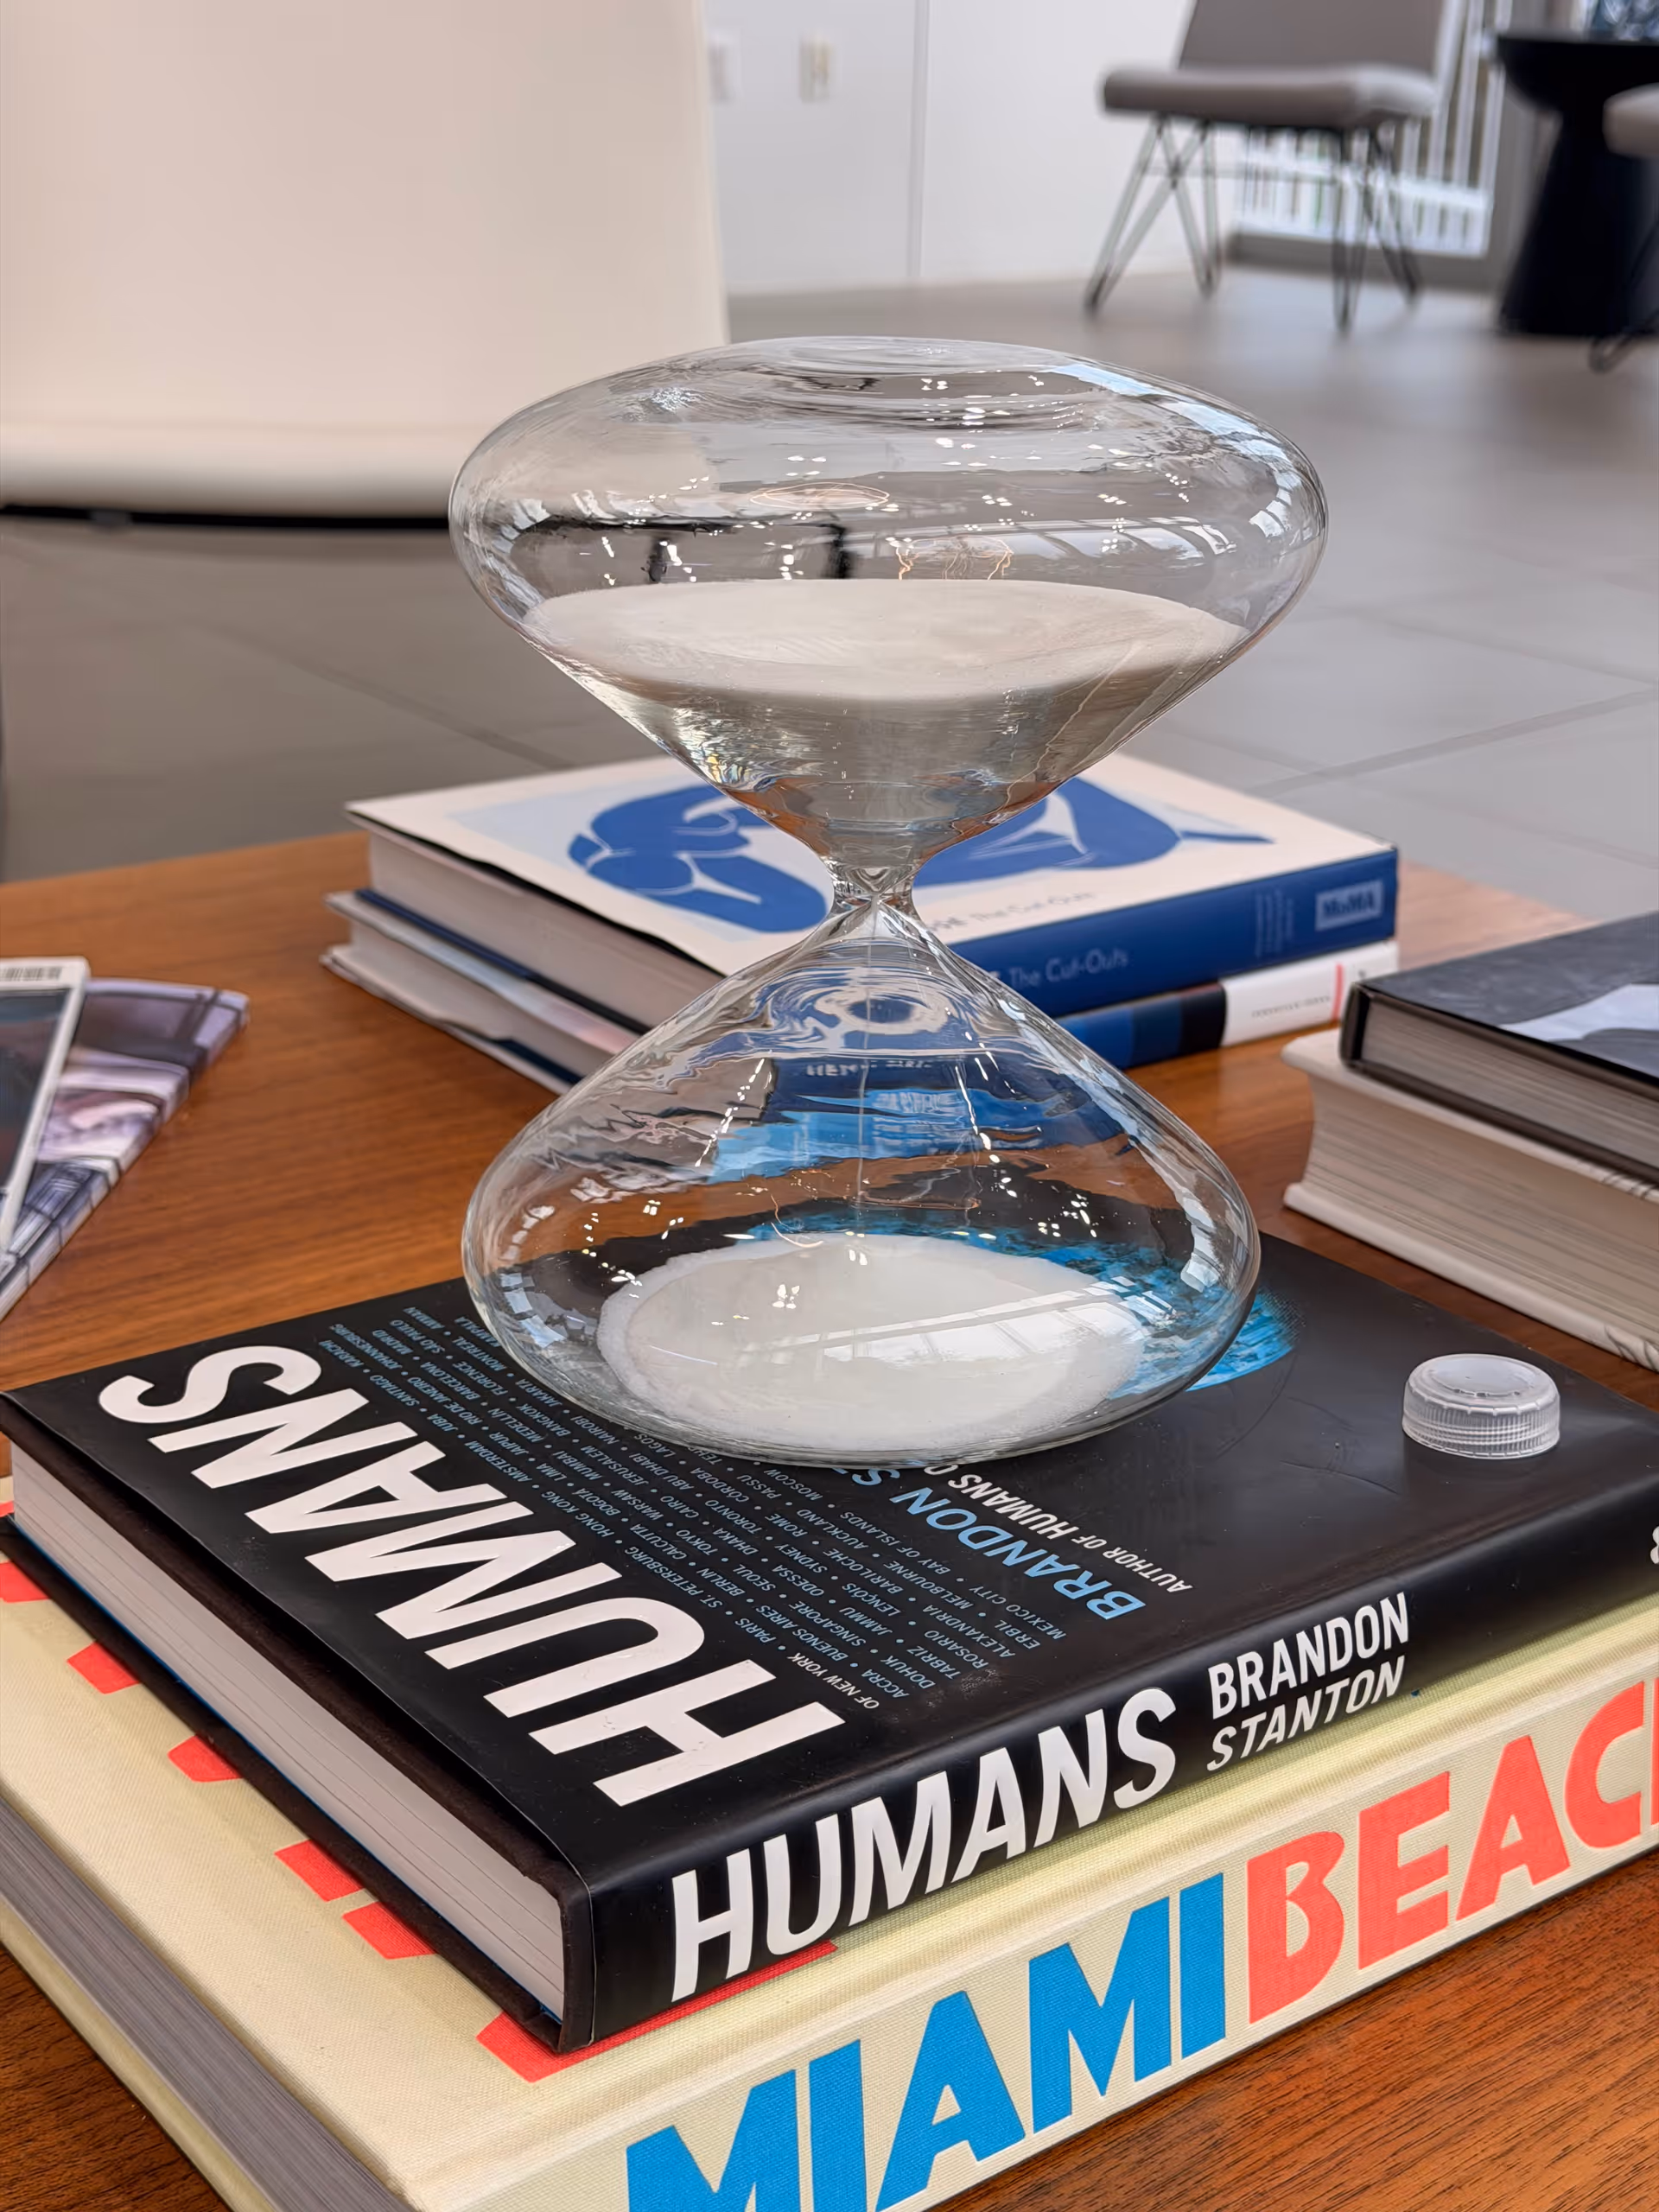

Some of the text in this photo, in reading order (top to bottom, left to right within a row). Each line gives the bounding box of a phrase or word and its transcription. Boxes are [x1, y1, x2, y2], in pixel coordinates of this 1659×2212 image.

[391, 1320, 425, 1340] PAULO
[404, 1307, 444, 1329] AMMAN
[453, 1337, 506, 1370] MONTREAL
[453, 1362, 508, 1395] FLORENCE
[516, 1379, 562, 1407] JAKARTA
[516, 1404, 570, 1436] BANGKOK
[570, 1416, 619, 1444] NAIROBI
[634, 1433, 676, 1457] LAGOS
[581, 1446, 648, 1484] JERUSALEM
[629, 1453, 669, 1475] DHABI
[664, 1476, 694, 1490] ABU
[690, 1468, 749, 1502] CÓRDOBA
[736, 1475, 781, 1498] PASSU
[330, 1324, 909, 1697] ACCRA BUENOS AIRES BERLIN CALCUTTA BOGOTÁ LIMA JAIPUR RIO DE JANEIRO JOHANNESBURG
[372, 1330, 935, 1688] DOHUK SINGAPORE SEOUL TOKYO WARSAW MUMBAI MEDELLÍN BARCELONA MADRID
[660, 1496, 699, 1517] CAIRO
[705, 1500, 761, 1534] TORONTO
[948, 1475, 1078, 1539] HUMANS
[319, 1340, 879, 1708] OF NEW YORK PARIS ST. PETERSBURG HONG KONG AMSTERDAM JUBA SANTIAGO KARACHI
[765, 1514, 807, 1536] ROME
[797, 1510, 868, 1548] AUCKLAND
[713, 1529, 758, 1554] DHAKA
[764, 1470, 1066, 1639] MEXICO CITY BAY OF ISLANDS MOSCOW
[890, 1488, 1146, 1619] BRANDON
[1071, 1535, 1107, 1548] OF
[775, 1544, 827, 1573] SYDNEY
[823, 1548, 903, 1593] BARILOCHE
[1103, 1548, 1192, 1592] AUTHOR
[99, 1345, 845, 1806] HUMANS
[772, 1565, 824, 1596] ODESSA
[884, 1561, 973, 1609] MELBOURNE
[839, 1607, 893, 1635] JAMMU
[923, 1605, 1015, 1657] ALEXANDRIA
[995, 1620, 1040, 1649] ERBIL
[907, 1646, 960, 1679] TABRIZ
[925, 1630, 988, 1669] ROSARIO
[1208, 1592, 1408, 1719] BRANDON
[1207, 1655, 1405, 1771] STANTON
[671, 1688, 1176, 2002] HUMANS
[626, 1677, 1659, 2212] MIAMI BEAC
